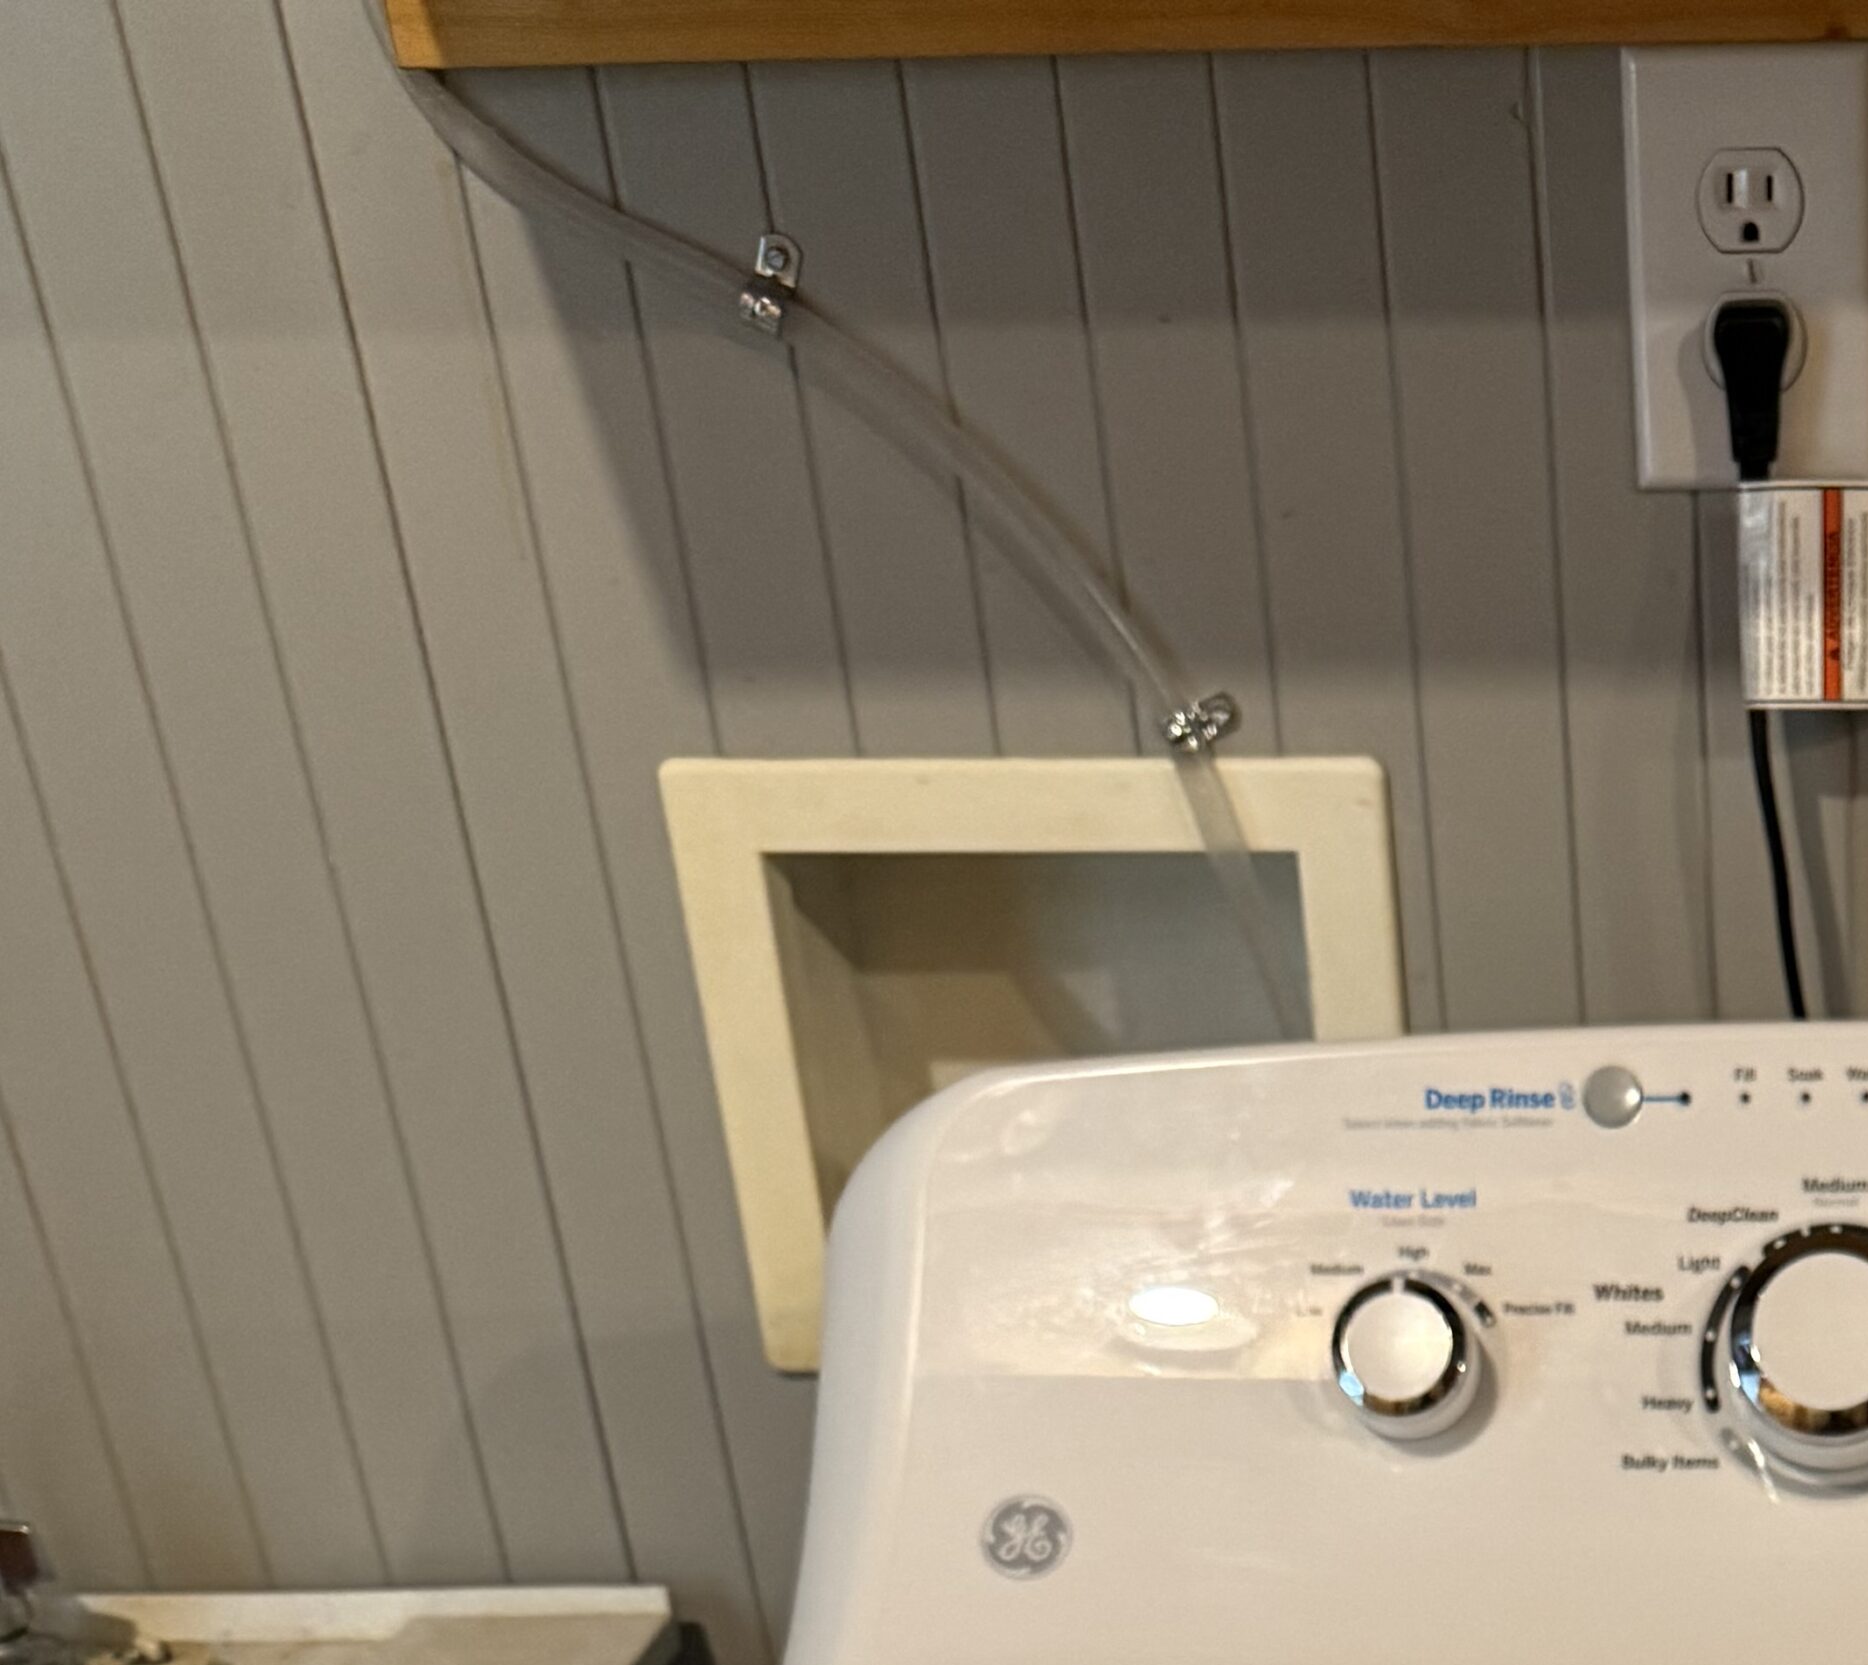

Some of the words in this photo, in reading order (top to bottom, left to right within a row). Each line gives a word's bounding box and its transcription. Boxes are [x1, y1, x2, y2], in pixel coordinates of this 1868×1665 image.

[1424, 1088, 1486, 1113] Deep
[1489, 1088, 1555, 1109] Rinse
[1349, 1188, 1413, 1208] Water
[1420, 1187, 1477, 1208] Level
[1687, 1207, 1779, 1224] DeepClean
[1397, 1246, 1429, 1261] High
[1678, 1256, 1720, 1275] Light
[1594, 1284, 1664, 1302] Whites
[1625, 1321, 1692, 1335] Medium
[1642, 1396, 1695, 1413] Heavy
[1621, 1455, 1669, 1473] Bulky
[1672, 1455, 1719, 1470] Items
